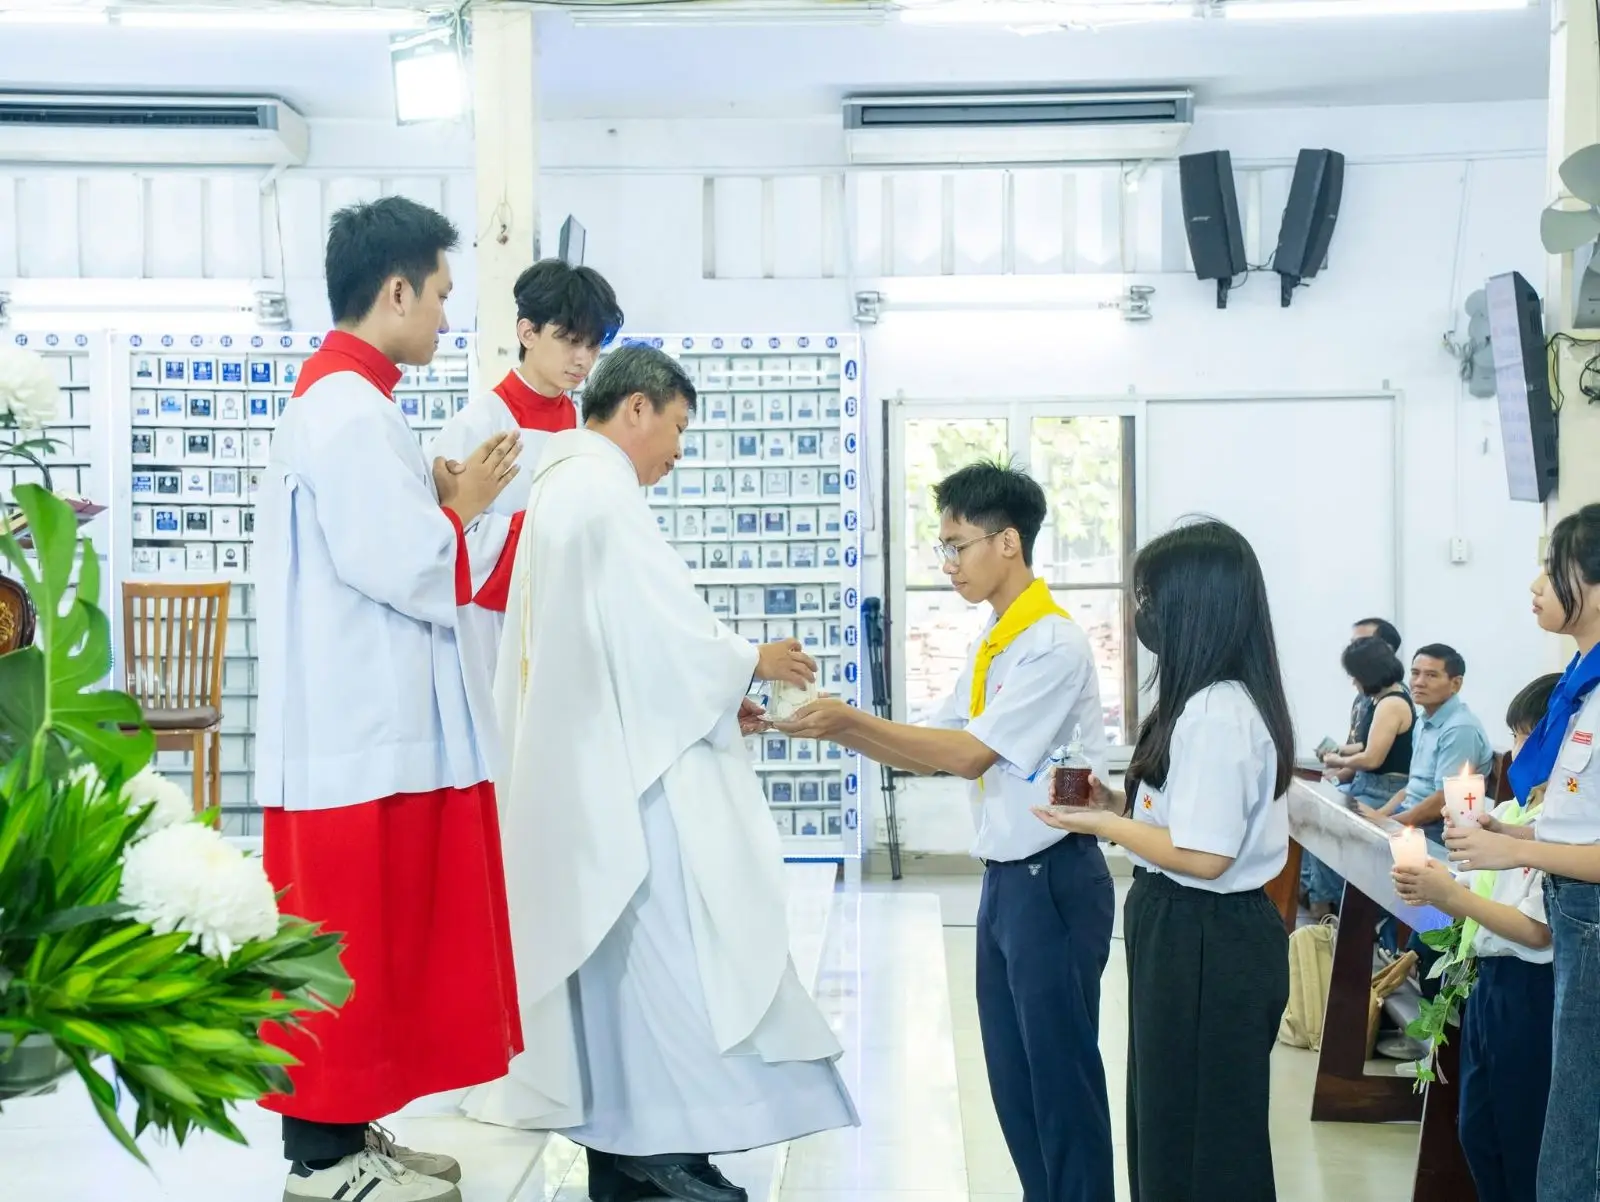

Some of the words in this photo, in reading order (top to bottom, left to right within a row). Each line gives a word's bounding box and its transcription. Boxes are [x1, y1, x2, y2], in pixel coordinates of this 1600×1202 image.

[847, 361, 857, 379] A
[847, 398, 857, 416] B
[846, 434, 856, 452] C
[847, 471, 856, 488] D
[848, 511, 857, 529] E
[848, 548, 857, 566] F
[846, 589, 857, 607] G
[847, 627, 857, 645] H
[848, 776, 857, 793] L
[847, 810, 857, 828] M
